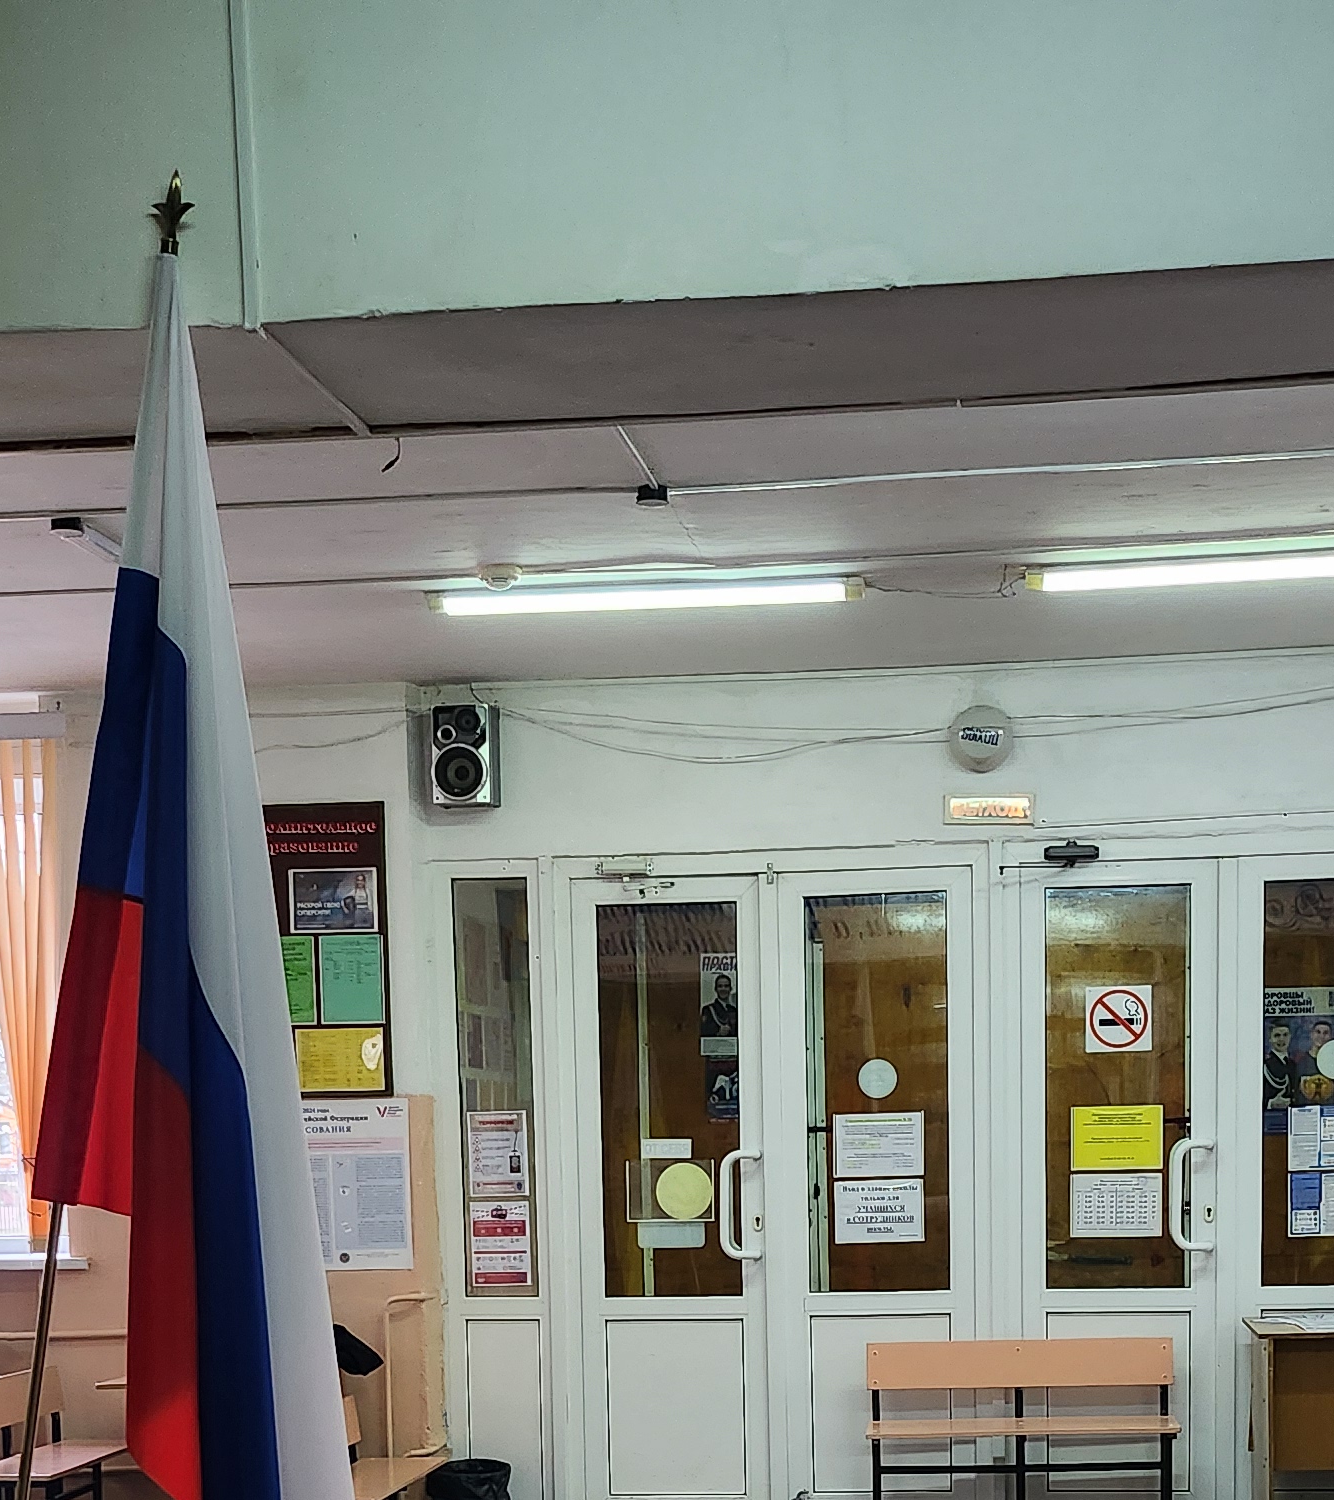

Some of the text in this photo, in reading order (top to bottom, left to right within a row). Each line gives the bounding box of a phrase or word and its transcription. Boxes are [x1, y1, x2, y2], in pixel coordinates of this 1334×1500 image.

[952, 801, 1026, 818] ВЫХОД
[329, 1114, 369, 1124] Федерации
[852, 1215, 915, 1224] СОТРУДНИКОВ
